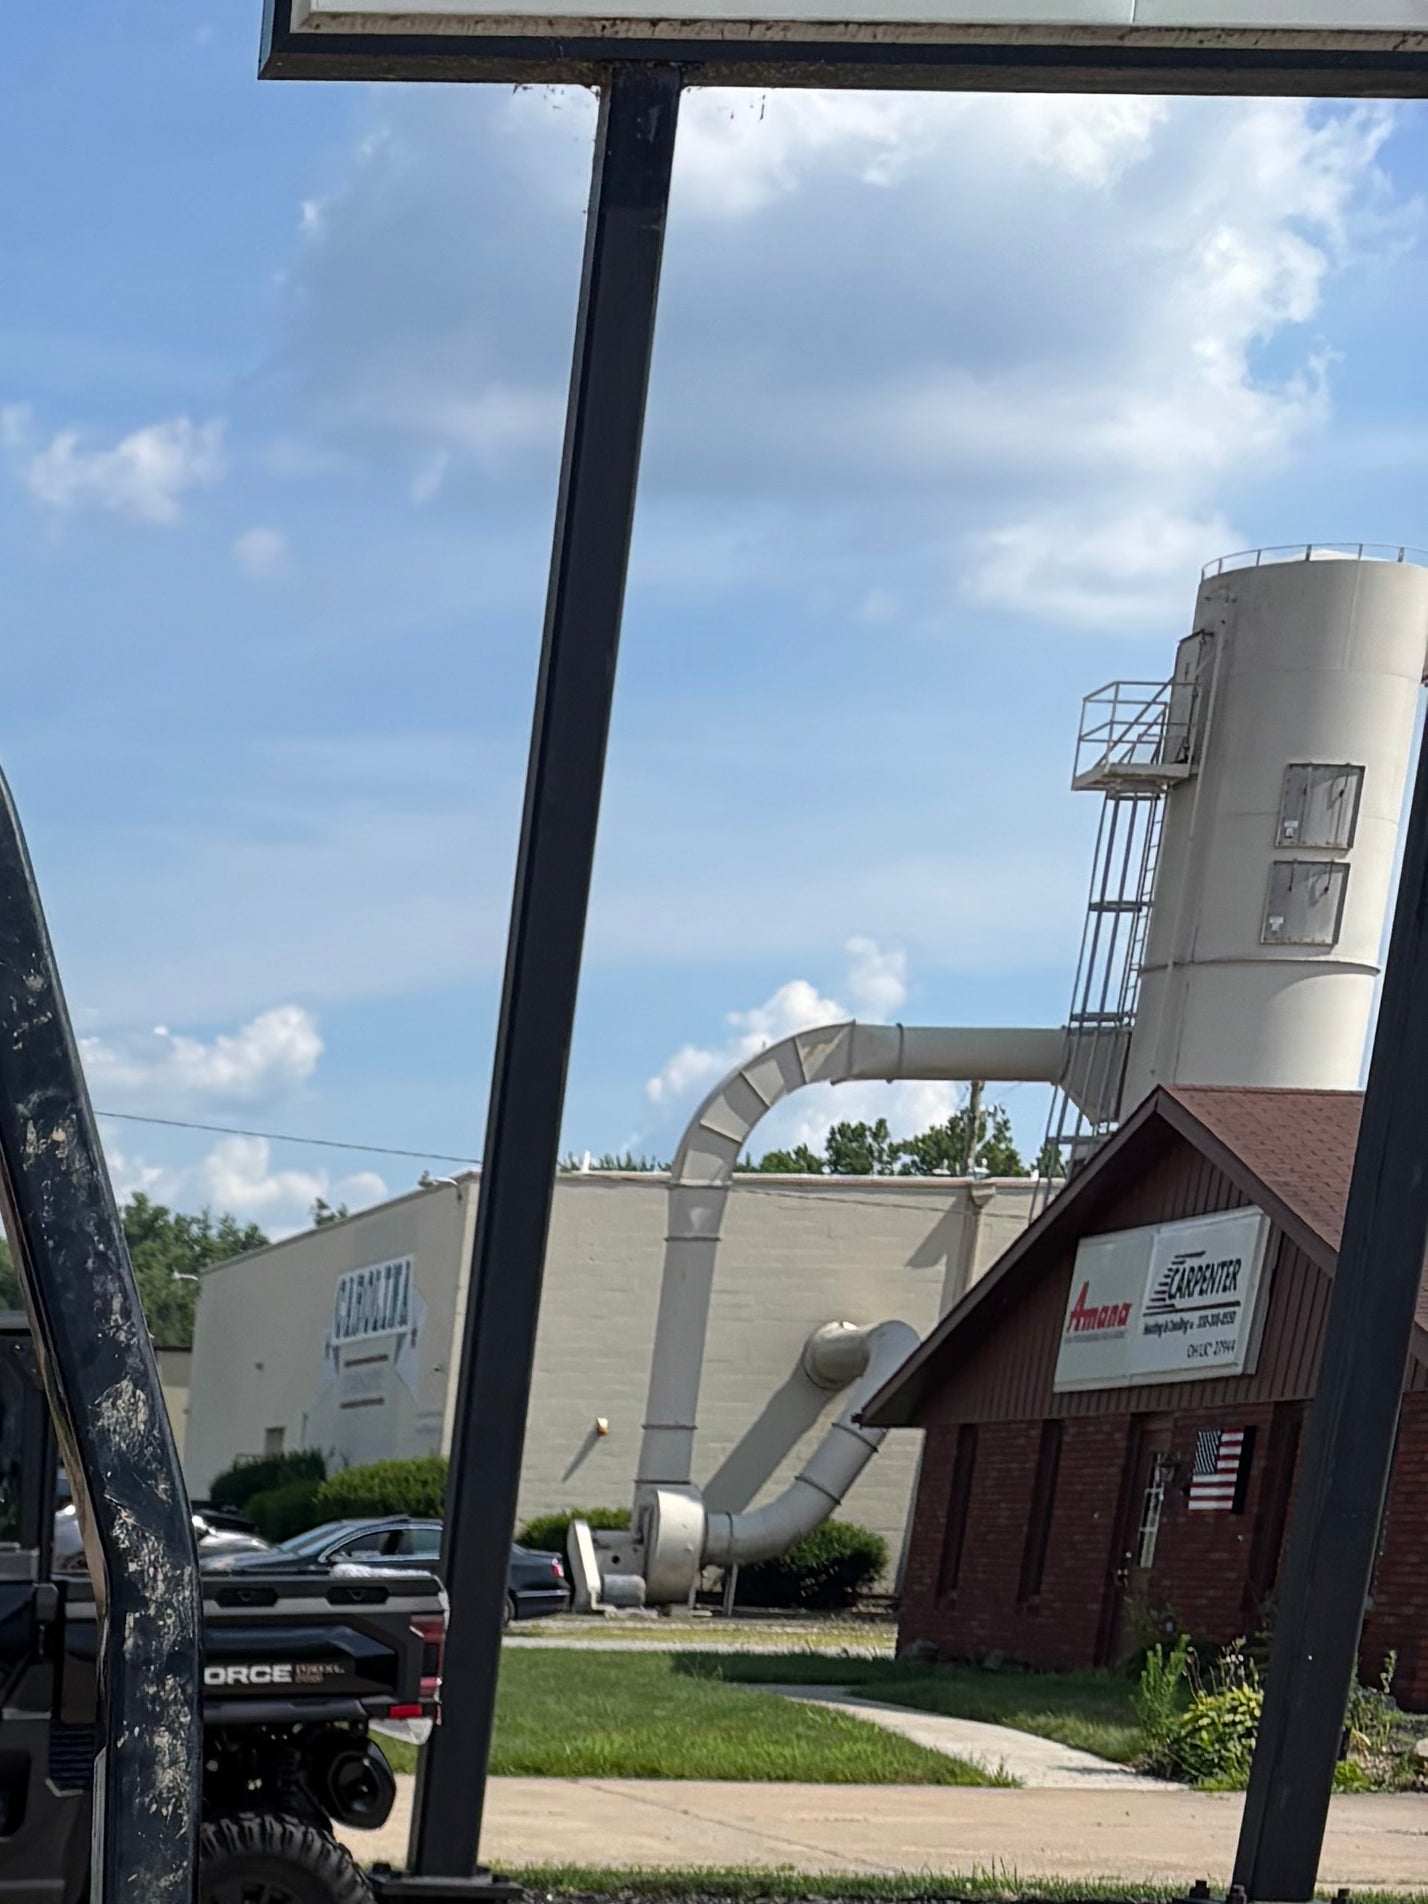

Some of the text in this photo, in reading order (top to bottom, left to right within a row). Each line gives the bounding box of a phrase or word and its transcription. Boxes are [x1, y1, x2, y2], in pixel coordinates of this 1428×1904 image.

[1168, 1259, 1242, 1300] CARPENTER
[1066, 1279, 1133, 1333] Amana
[204, 1664, 293, 1686] ORCE
